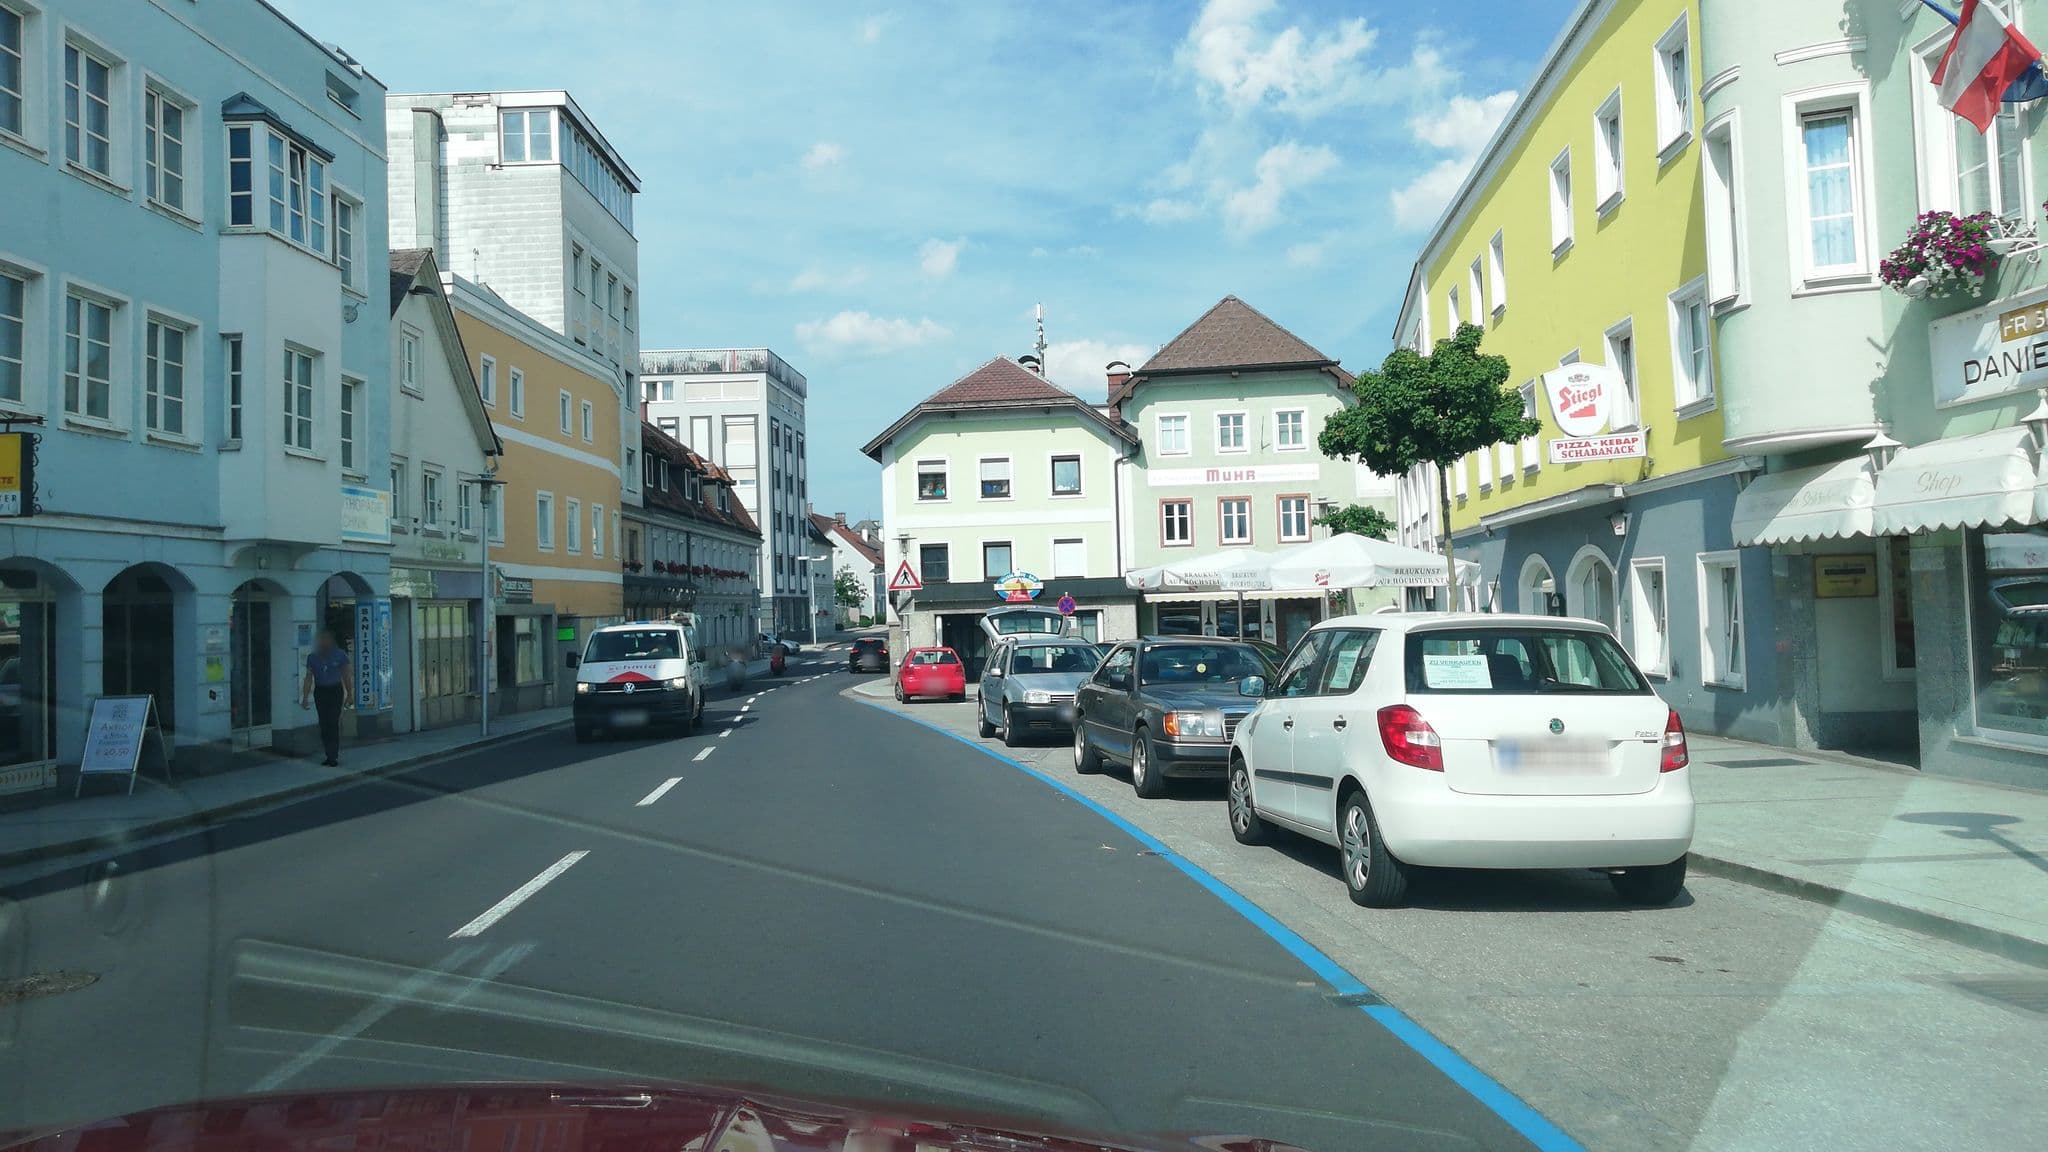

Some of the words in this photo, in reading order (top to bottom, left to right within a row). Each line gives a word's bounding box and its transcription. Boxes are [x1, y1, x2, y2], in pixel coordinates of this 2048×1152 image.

[1559, 384, 1602, 412] Stiegl
[1556, 440, 1592, 450] PIZZA
[1600, 437, 1639, 447] KEBAP
[1561, 445, 1635, 459] SCHABANACK
[1917, 472, 1961, 495] Shop
[1394, 567, 1441, 576] BRAUKUNST
